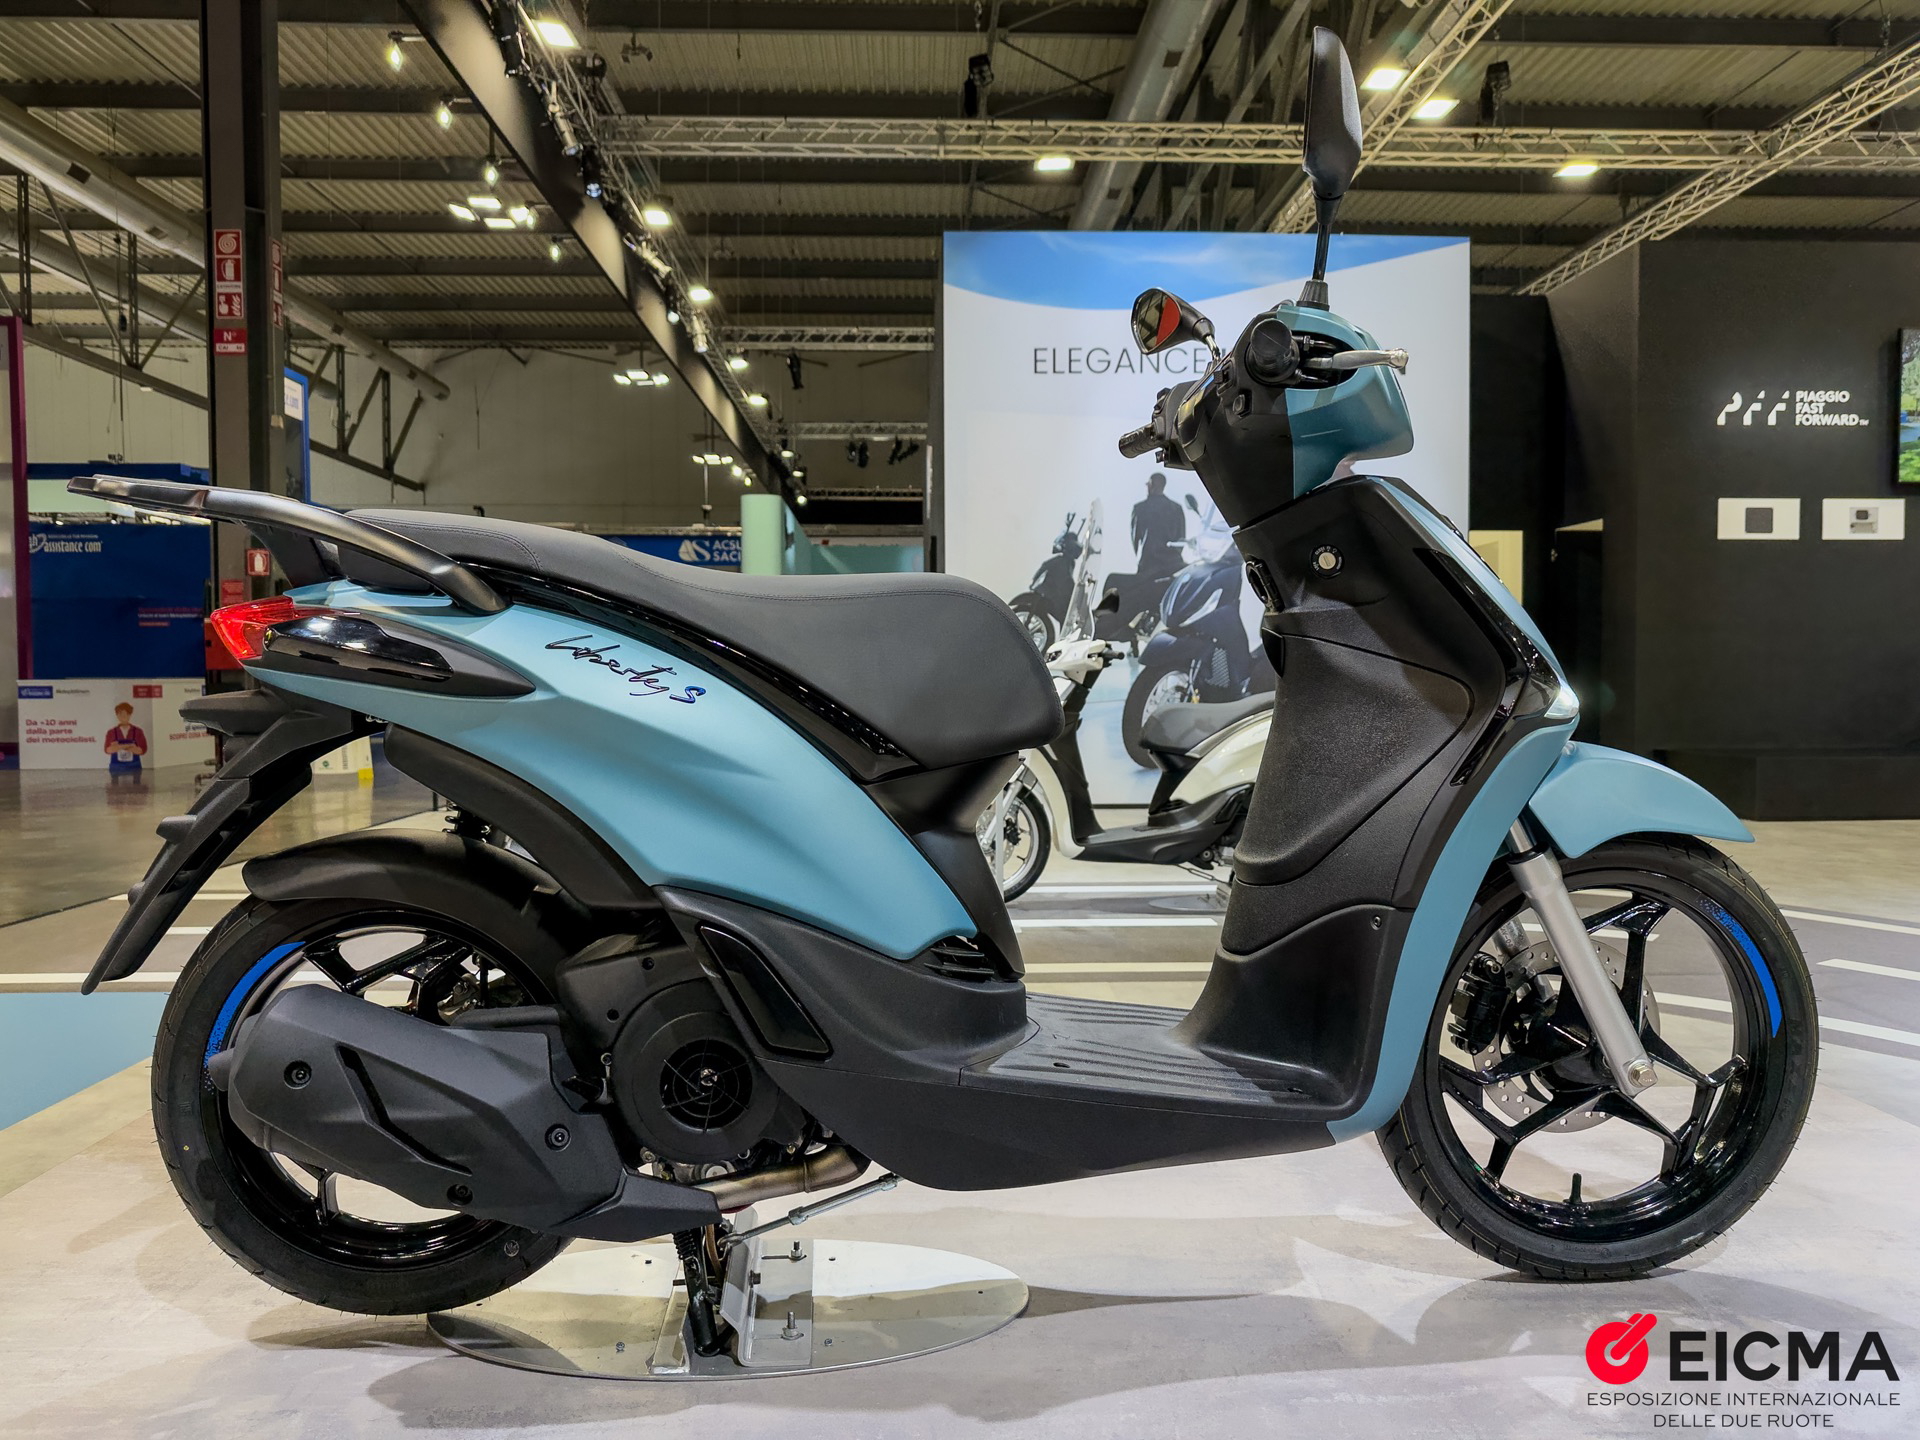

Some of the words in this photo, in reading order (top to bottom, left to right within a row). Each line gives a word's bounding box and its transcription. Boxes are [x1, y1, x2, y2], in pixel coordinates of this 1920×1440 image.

[1034, 347, 1206, 374] ELEGANCE
[1795, 390, 1850, 403] PIAGGIO
[1795, 402, 1826, 414] FAST
[1795, 413, 1859, 426] FORWARD
[669, 685, 706, 704] S
